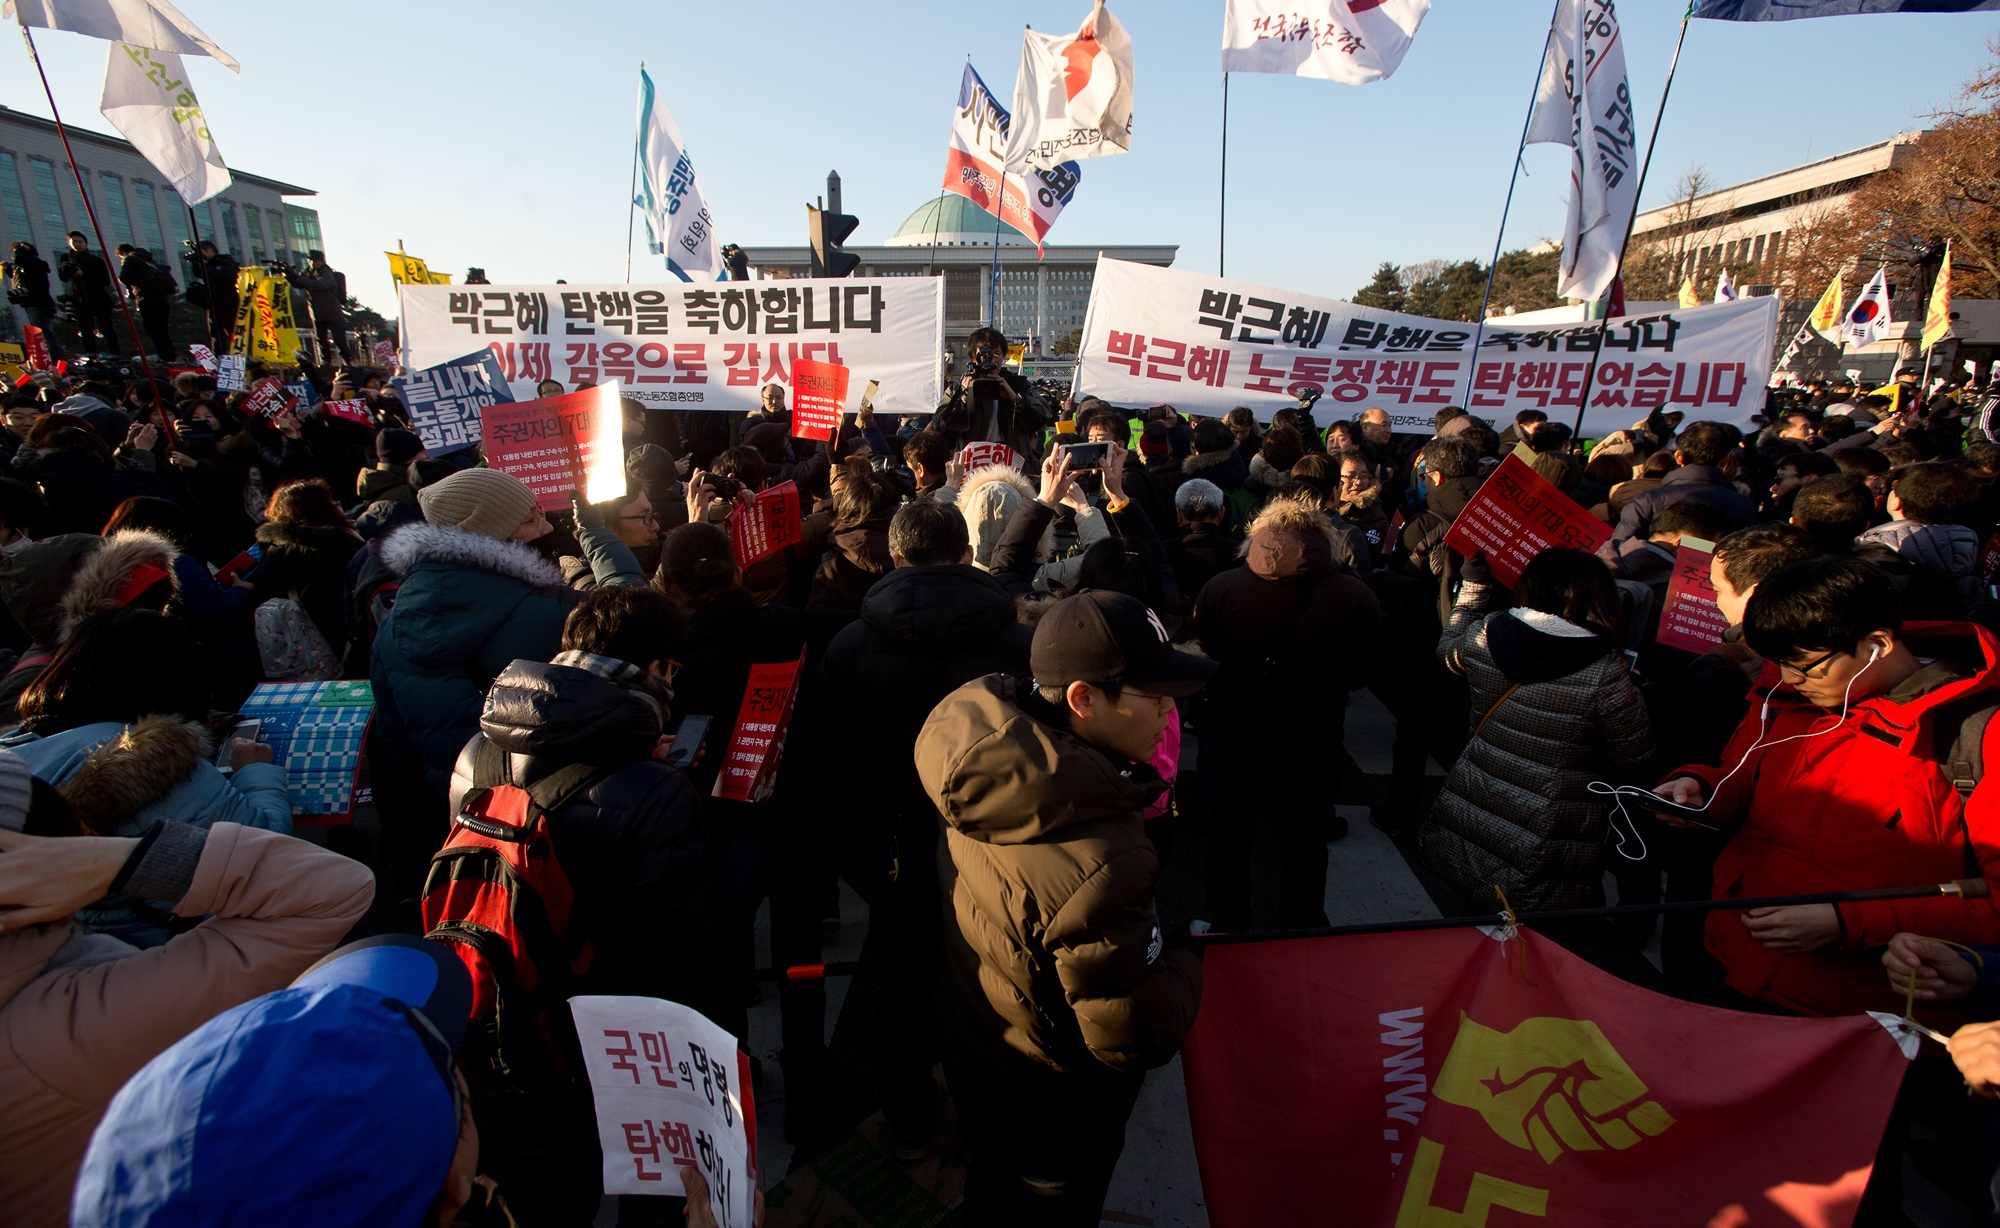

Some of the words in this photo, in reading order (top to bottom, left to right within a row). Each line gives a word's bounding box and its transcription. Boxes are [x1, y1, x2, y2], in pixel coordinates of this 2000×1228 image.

[449, 291, 548, 335] 박근혜
[560, 290, 669, 335] 탄핵을
[683, 285, 886, 335] 축하합니다
[1198, 288, 1331, 349] 박근혜
[403, 362, 493, 405] 끝내자
[488, 341, 552, 384] 이제
[565, 342, 708, 385] 감옥으로
[798, 374, 833, 391] 주권자의
[1107, 330, 1231, 388] 박근혜
[1244, 353, 1460, 404] 노동정책도
[1470, 361, 1747, 408] 탄핵되었습니다
[493, 416, 564, 444] 주권자의
[772, 516, 787, 544] 요구
[1494, 472, 1542, 516] 주권자의
[1534, 505, 1566, 535] 7대
[1558, 525, 1596, 551] 요구
[1675, 613, 1687, 623] 정치
[1678, 602, 1695, 614] 관련자
[1681, 592, 1697, 603] 대통령
[603, 1030, 696, 1091] 국민의
[687, 1041, 733, 1128] 명령
